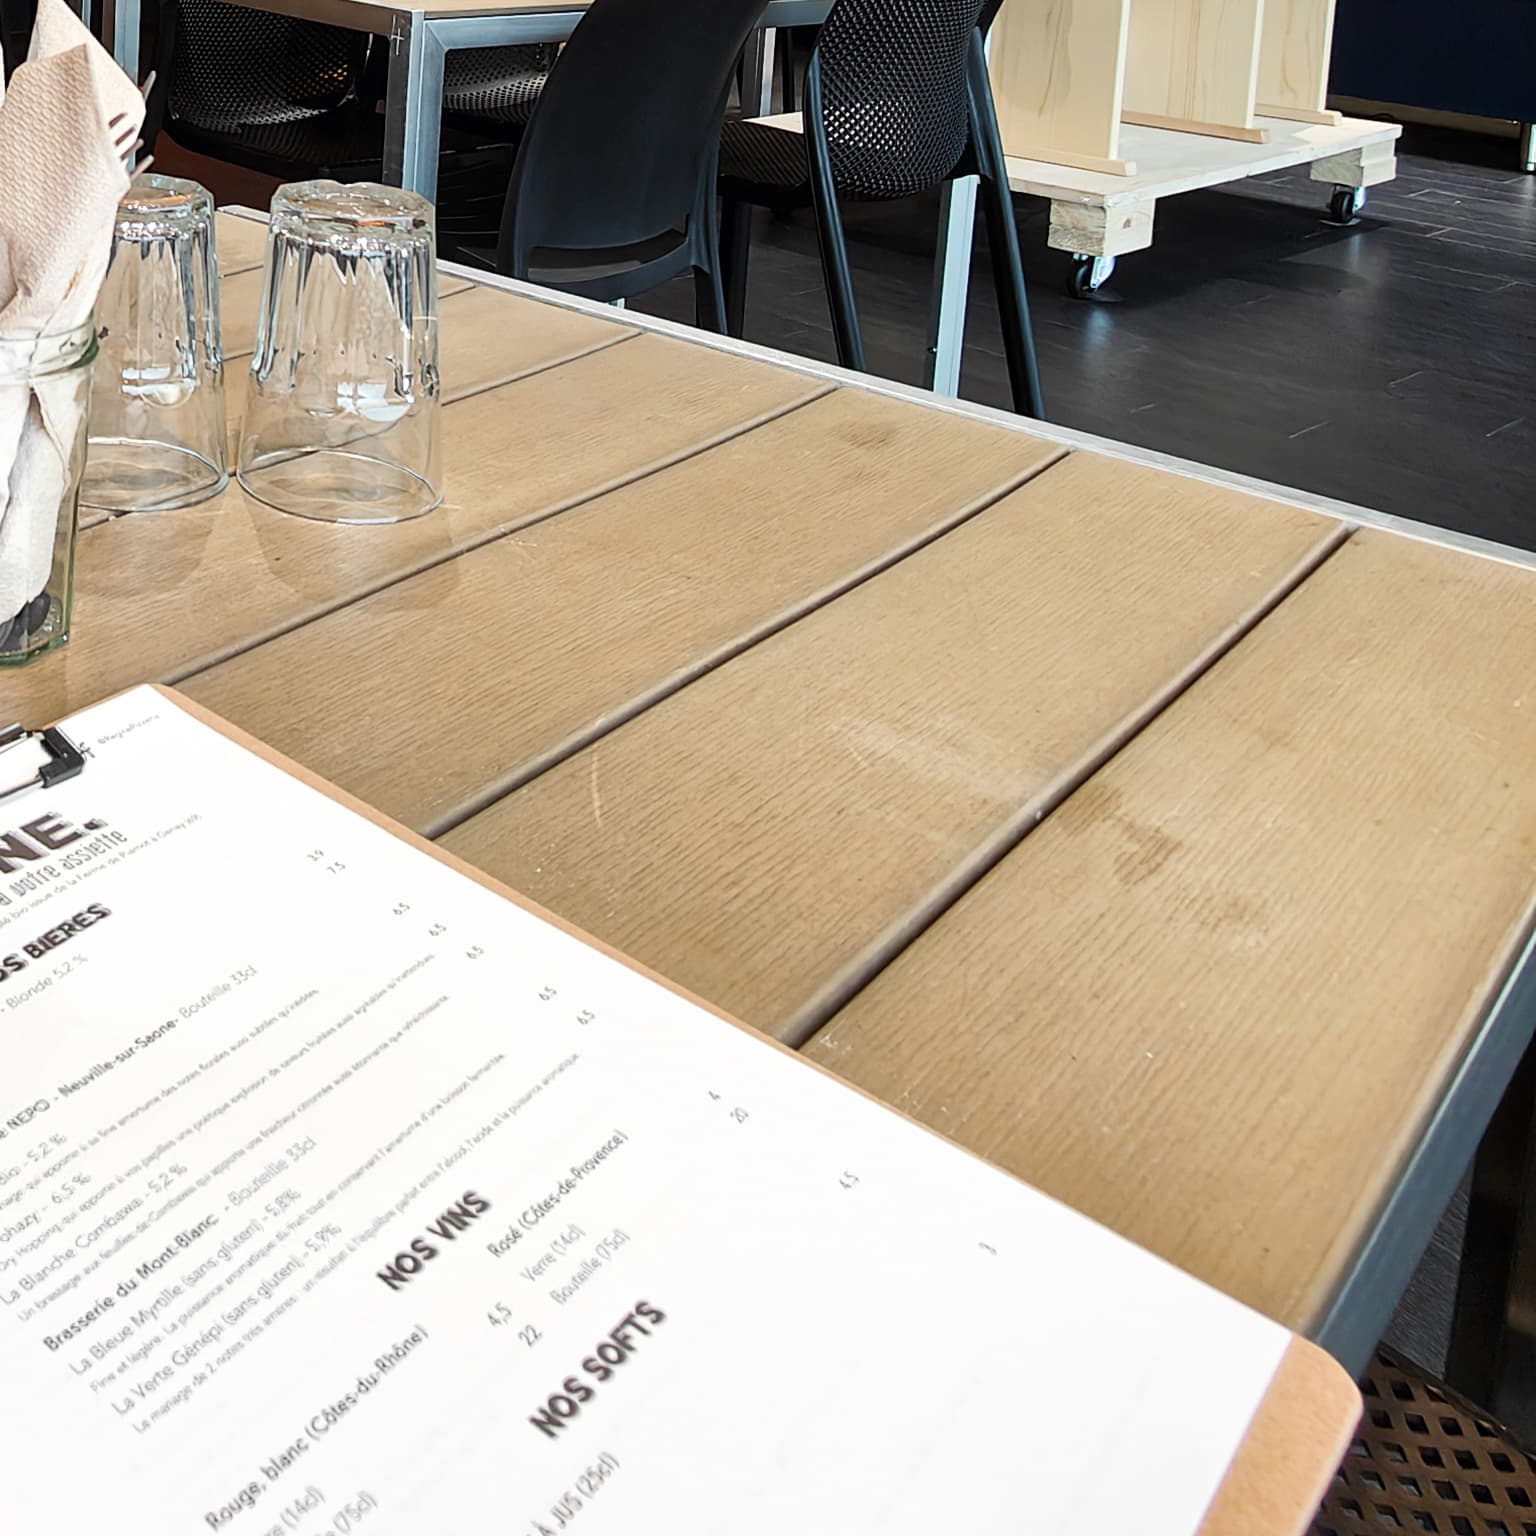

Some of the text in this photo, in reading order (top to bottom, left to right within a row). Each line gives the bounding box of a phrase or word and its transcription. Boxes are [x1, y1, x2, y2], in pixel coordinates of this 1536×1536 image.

[58, 831, 127, 870] assiette
[22, 903, 112, 959] BIERES
[6, 1099, 50, 1130] NEPO
[376, 1190, 492, 1291] NOS VINS
[486, 1225, 523, 1258] Rosé
[18, 1248, 78, 1292] Blanche
[43, 1297, 116, 1352] Brasserie
[89, 1326, 134, 1361] Bleue
[518, 1324, 542, 1348] 22
[129, 1365, 175, 1400] Verte
[528, 1300, 667, 1439] NOS SOFTS
[204, 1482, 267, 1532] Rouge,
[259, 1438, 309, 1482] blanc
[550, 1491, 583, 1530] JUS
